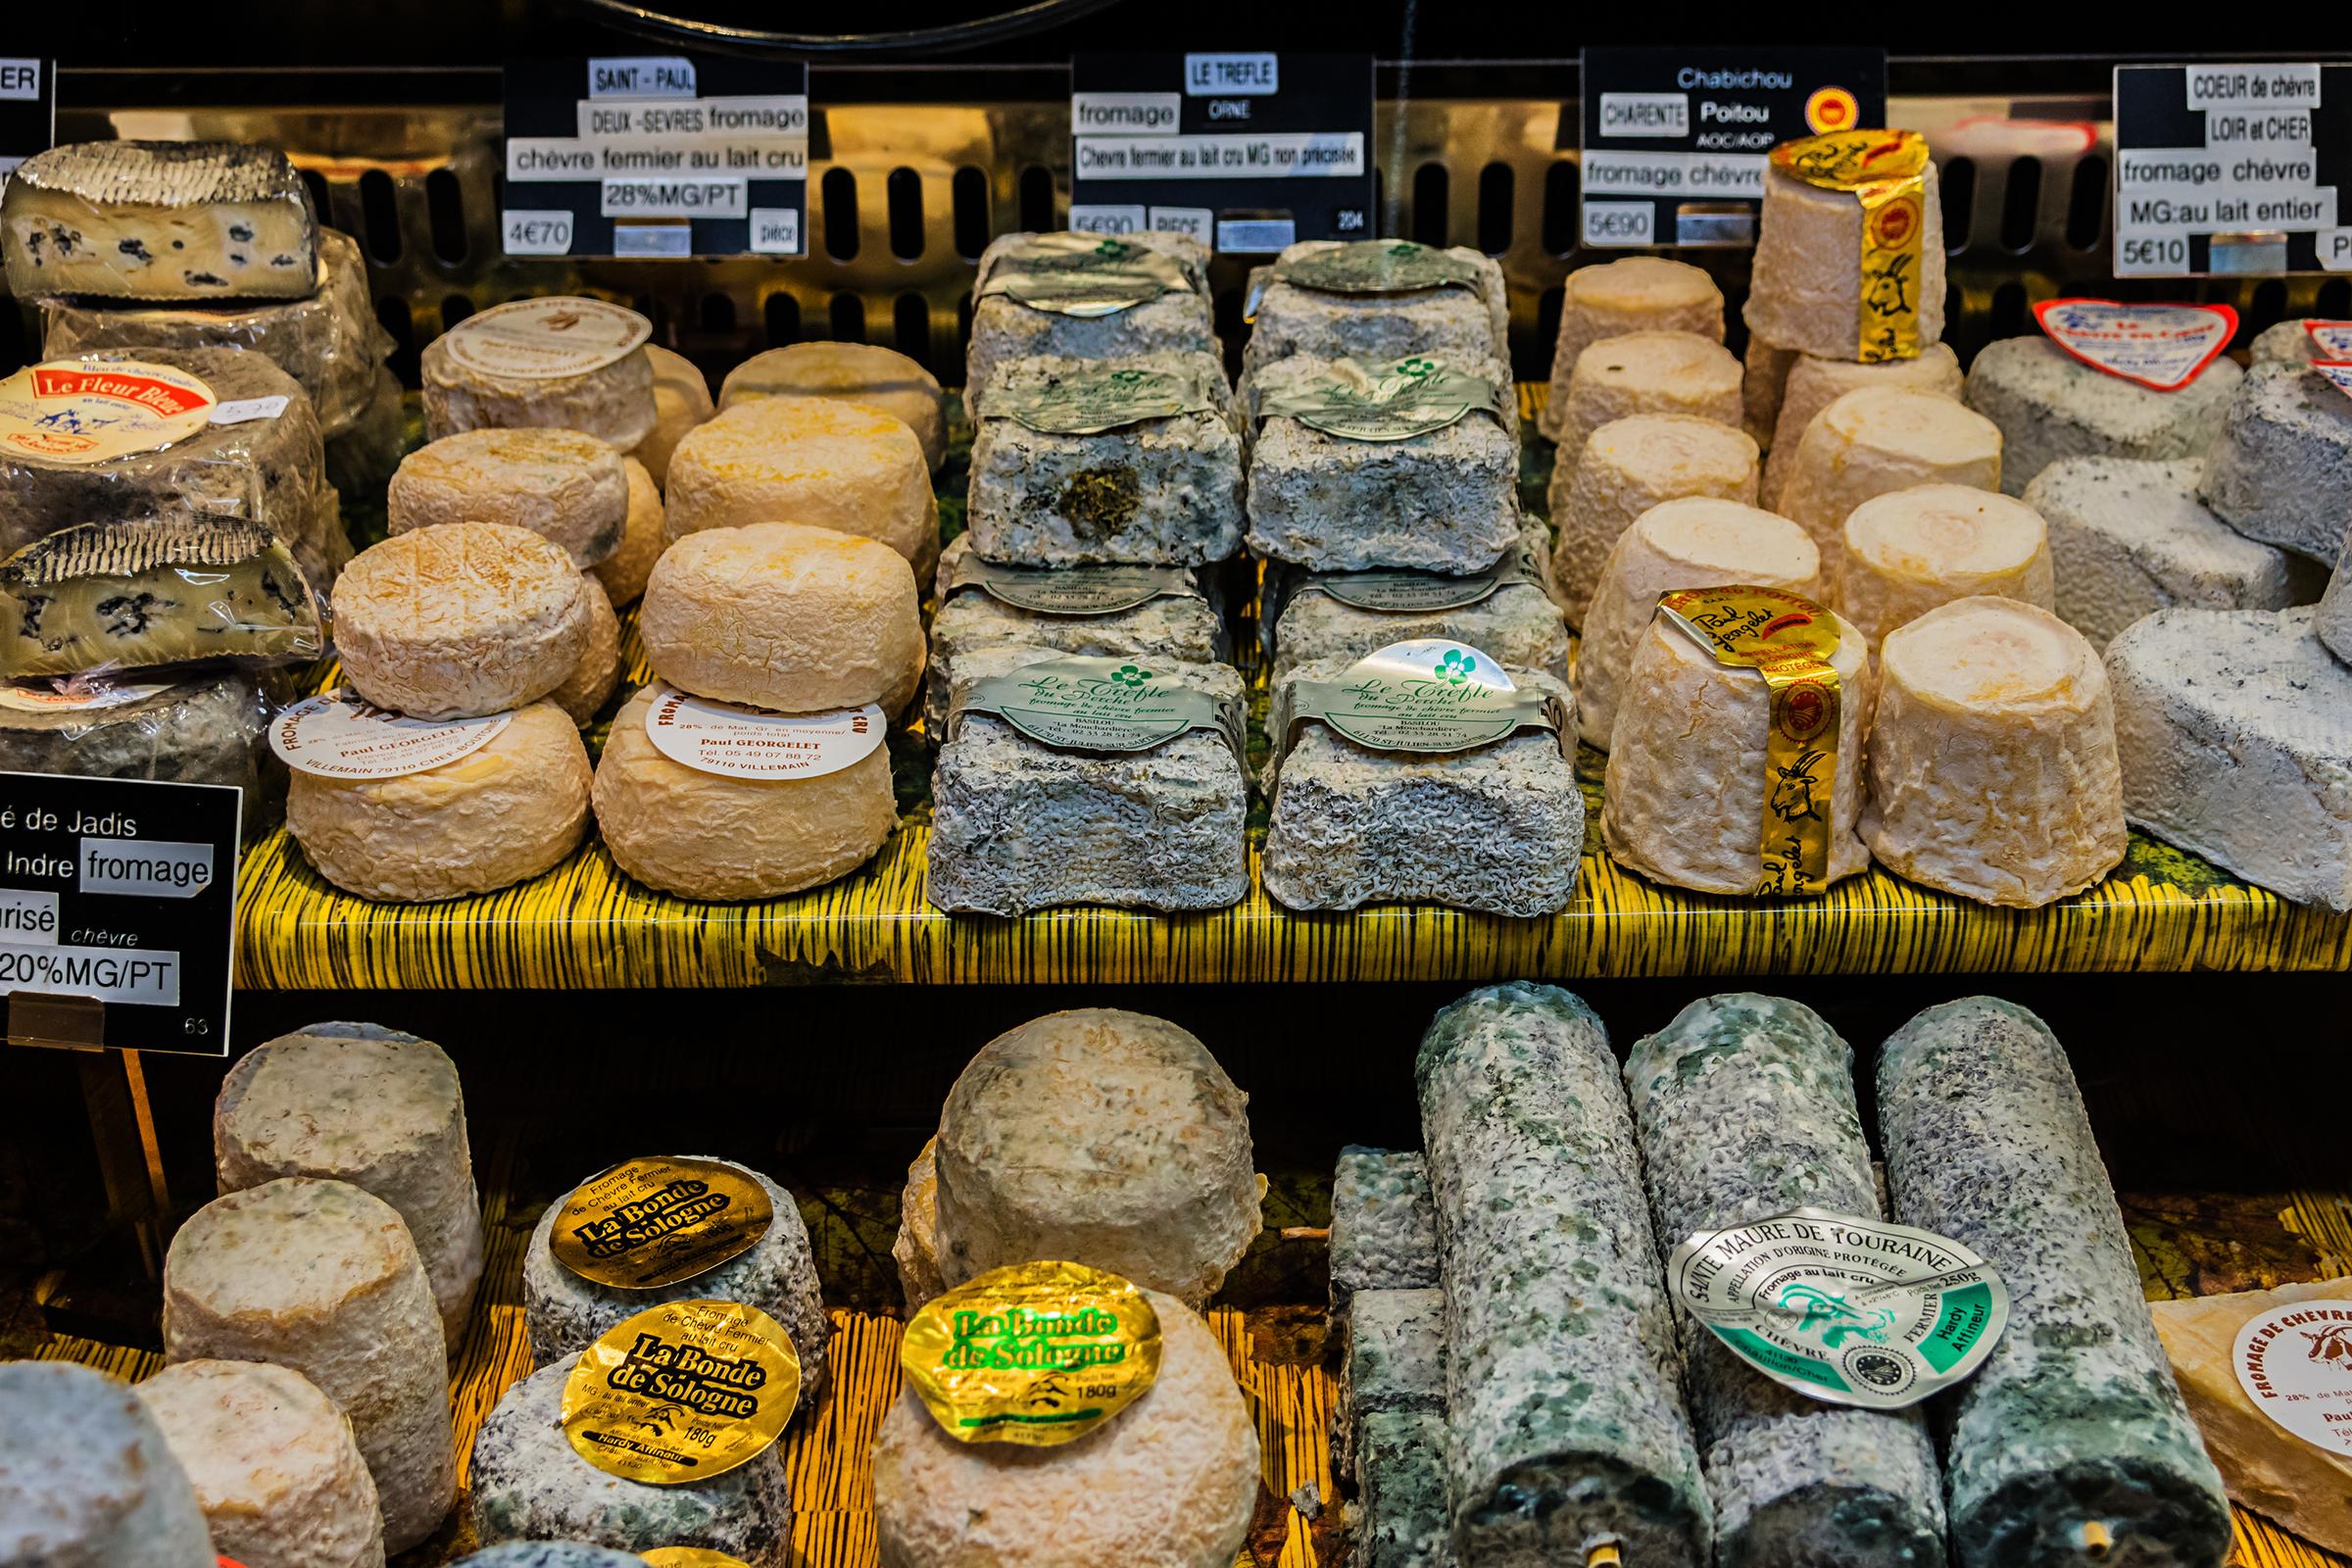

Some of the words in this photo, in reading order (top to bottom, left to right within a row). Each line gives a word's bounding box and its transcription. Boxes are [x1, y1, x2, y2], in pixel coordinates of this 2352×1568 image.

[1, 68, 35, 89] ER
[596, 67, 637, 91] SAINT
[657, 67, 694, 91] PAUL
[1192, 60, 1211, 86] LE
[1217, 60, 1273, 86] TREFLE
[1677, 68, 1793, 89] Chabichou
[2193, 75, 2247, 99] COEUR
[2250, 75, 2267, 96] de
[2271, 74, 2316, 96] chèvre
[592, 111, 631, 133] DEUX
[709, 105, 806, 131] fromage
[1079, 104, 1174, 130] fromage
[1208, 100, 1251, 121] ORNE
[1605, 102, 1687, 127] CHARENTE
[1700, 101, 1770, 123] Poitou
[2210, 119, 2244, 141] LOIR
[2250, 120, 2264, 140] et
[2266, 117, 2309, 140] CHER
[516, 147, 595, 171] chèvre
[603, 146, 682, 170] fermier
[690, 151, 720, 169] au
[726, 146, 760, 168] lait
[765, 150, 804, 169] cru
[1129, 144, 1177, 168] fermier
[1180, 148, 1196, 167] au
[1200, 144, 1220, 167] lait
[1225, 147, 1244, 167] cru
[1248, 143, 1270, 166] MG
[1587, 158, 1683, 186] fromage
[2124, 159, 2221, 186] fromage
[2232, 158, 2312, 182] chèvre
[606, 182, 742, 208] 28%MG/PT
[2215, 198, 2249, 221] lait
[2257, 197, 2323, 221] entier
[510, 220, 569, 245] 4€70
[1589, 211, 1649, 237] 5€90
[2124, 239, 2185, 265] 5€10
[45, 377, 74, 394] Le
[78, 376, 141, 397] Fleur
[135, 386, 186, 416] Bleue
[1690, 606, 1745, 630] Paul
[1705, 608, 1774, 653] Georgelet
[1018, 675, 1065, 691] Le
[1342, 678, 1393, 694] Le
[1061, 690, 1132, 706] Perche
[1385, 693, 1456, 706] Perche
[280, 704, 318, 753] FROMAGE
[340, 746, 374, 759] Paul
[379, 724, 468, 752] GEORGELET
[700, 738, 732, 747] Paul
[736, 739, 821, 751] GEORGELET
[306, 759, 373, 775] VILLEMAIN
[700, 758, 735, 768] 79110
[740, 760, 810, 771] VILLEMAIN
[25, 808, 58, 832] de
[67, 809, 138, 837] Jadis
[8, 850, 74, 878] Indre
[88, 850, 209, 888] fromage
[70, 927, 139, 947] chèvre
[0, 953, 172, 991] 20%MG/PT
[184, 1017, 209, 1035] 63
[571, 1205, 588, 1216] de
[587, 1181, 628, 1208] Chèvre
[628, 1164, 672, 1185] Fermier
[590, 1164, 640, 1196] Fromage
[602, 1202, 618, 1212] au
[616, 1189, 636, 1206] lait
[638, 1180, 657, 1193] cru
[579, 1218, 621, 1244] La
[619, 1180, 705, 1225] Bonde
[592, 1239, 626, 1257] de
[624, 1194, 727, 1246] Sologne
[1689, 1253, 1725, 1303] SAINTE
[1715, 1222, 1792, 1260] MAURE
[1792, 1222, 1826, 1242] DE
[1832, 1227, 1953, 1273] TOURAINE
[1725, 1251, 1772, 1304] APPELLATION
[1775, 1248, 1832, 1260] D'ORIGINE
[1834, 1250, 1908, 1278] PROTÉGÉE
[1758, 1267, 1802, 1300] Fromage
[1804, 1268, 1821, 1279] au
[1822, 1267, 1846, 1281] lait
[1851, 1273, 1876, 1285] cru
[1939, 1270, 1983, 1288] 250g
[662, 1311, 677, 1324] de
[724, 1324, 770, 1348] Fermier
[697, 1305, 749, 1329] Fromage
[959, 1311, 1004, 1337] La
[1009, 1311, 1114, 1338] Bonde
[1903, 1293, 1938, 1344] FERMIER
[1936, 1306, 1968, 1341] Hardy
[1951, 1302, 1986, 1352] Affineur
[680, 1331, 696, 1342] au
[699, 1334, 718, 1348] lait
[720, 1341, 739, 1352] cru
[1754, 1324, 1830, 1362] CHÈVRE
[2259, 1322, 2285, 1340] DE
[633, 1337, 670, 1364] La
[676, 1348, 762, 1388] Bonde
[947, 1343, 987, 1367] de
[993, 1342, 1123, 1371] Sologne
[2246, 1336, 2279, 1399] FROMAGE
[612, 1365, 647, 1390] de
[649, 1371, 755, 1415] Sologne
[1076, 1384, 1118, 1399] 180g
[598, 1433, 634, 1450] Hardy
[683, 1425, 717, 1448] 180g
